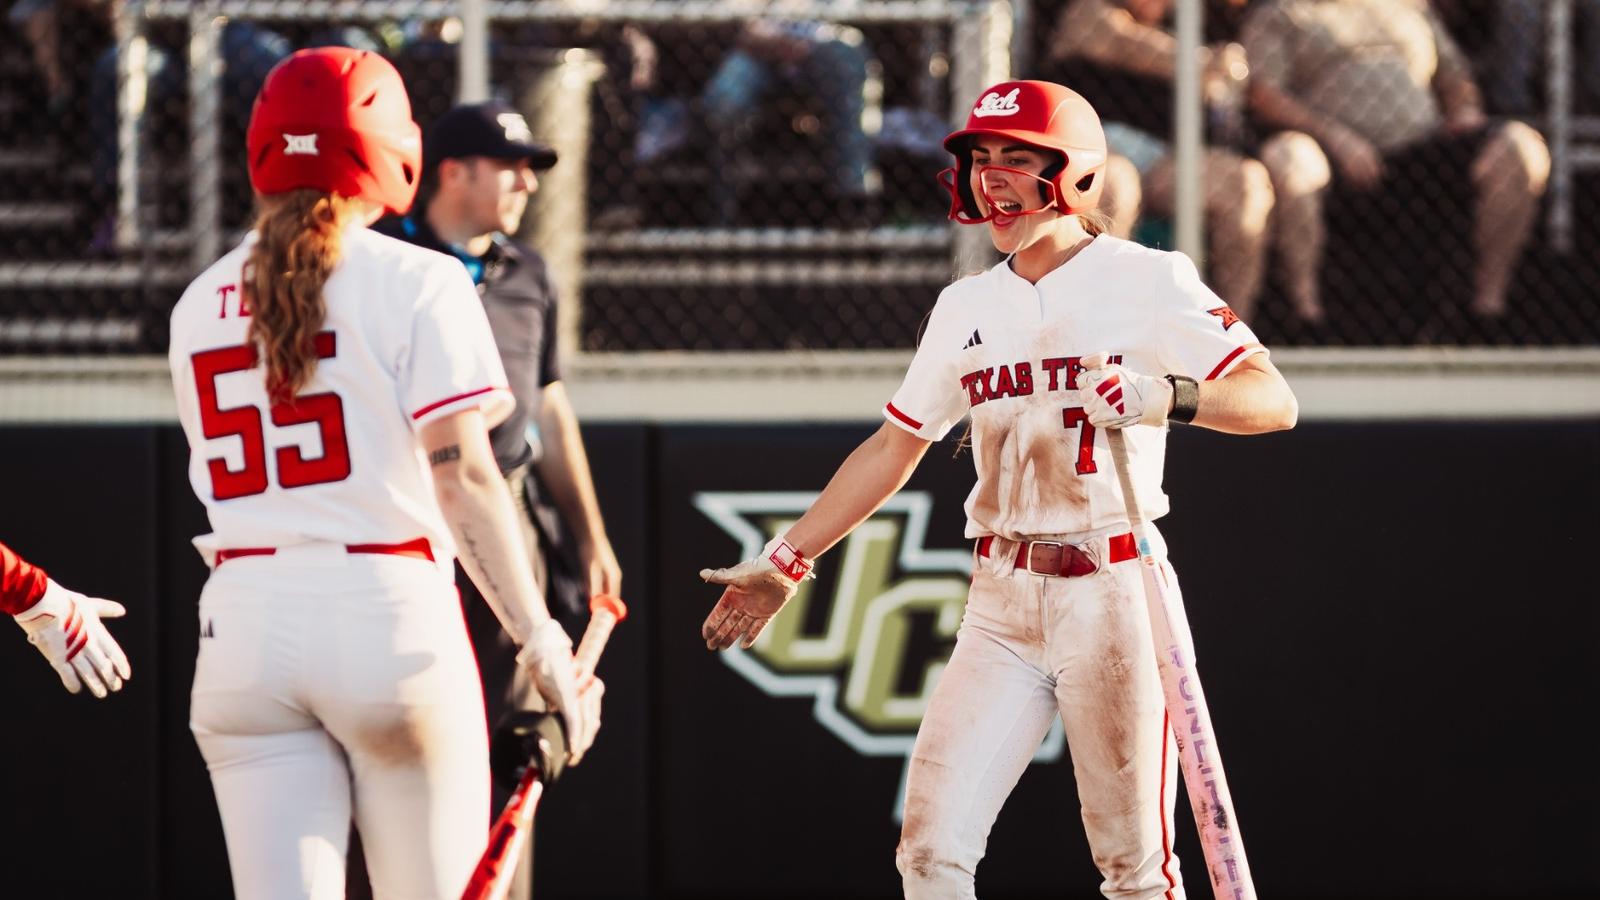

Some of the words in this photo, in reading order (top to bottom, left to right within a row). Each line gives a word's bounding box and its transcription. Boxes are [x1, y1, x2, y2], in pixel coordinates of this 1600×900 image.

[191, 331, 351, 501] 55
[961, 361, 1034, 408] TEXAS
[1041, 354, 1123, 392] TE
[1062, 406, 1098, 476] 7
